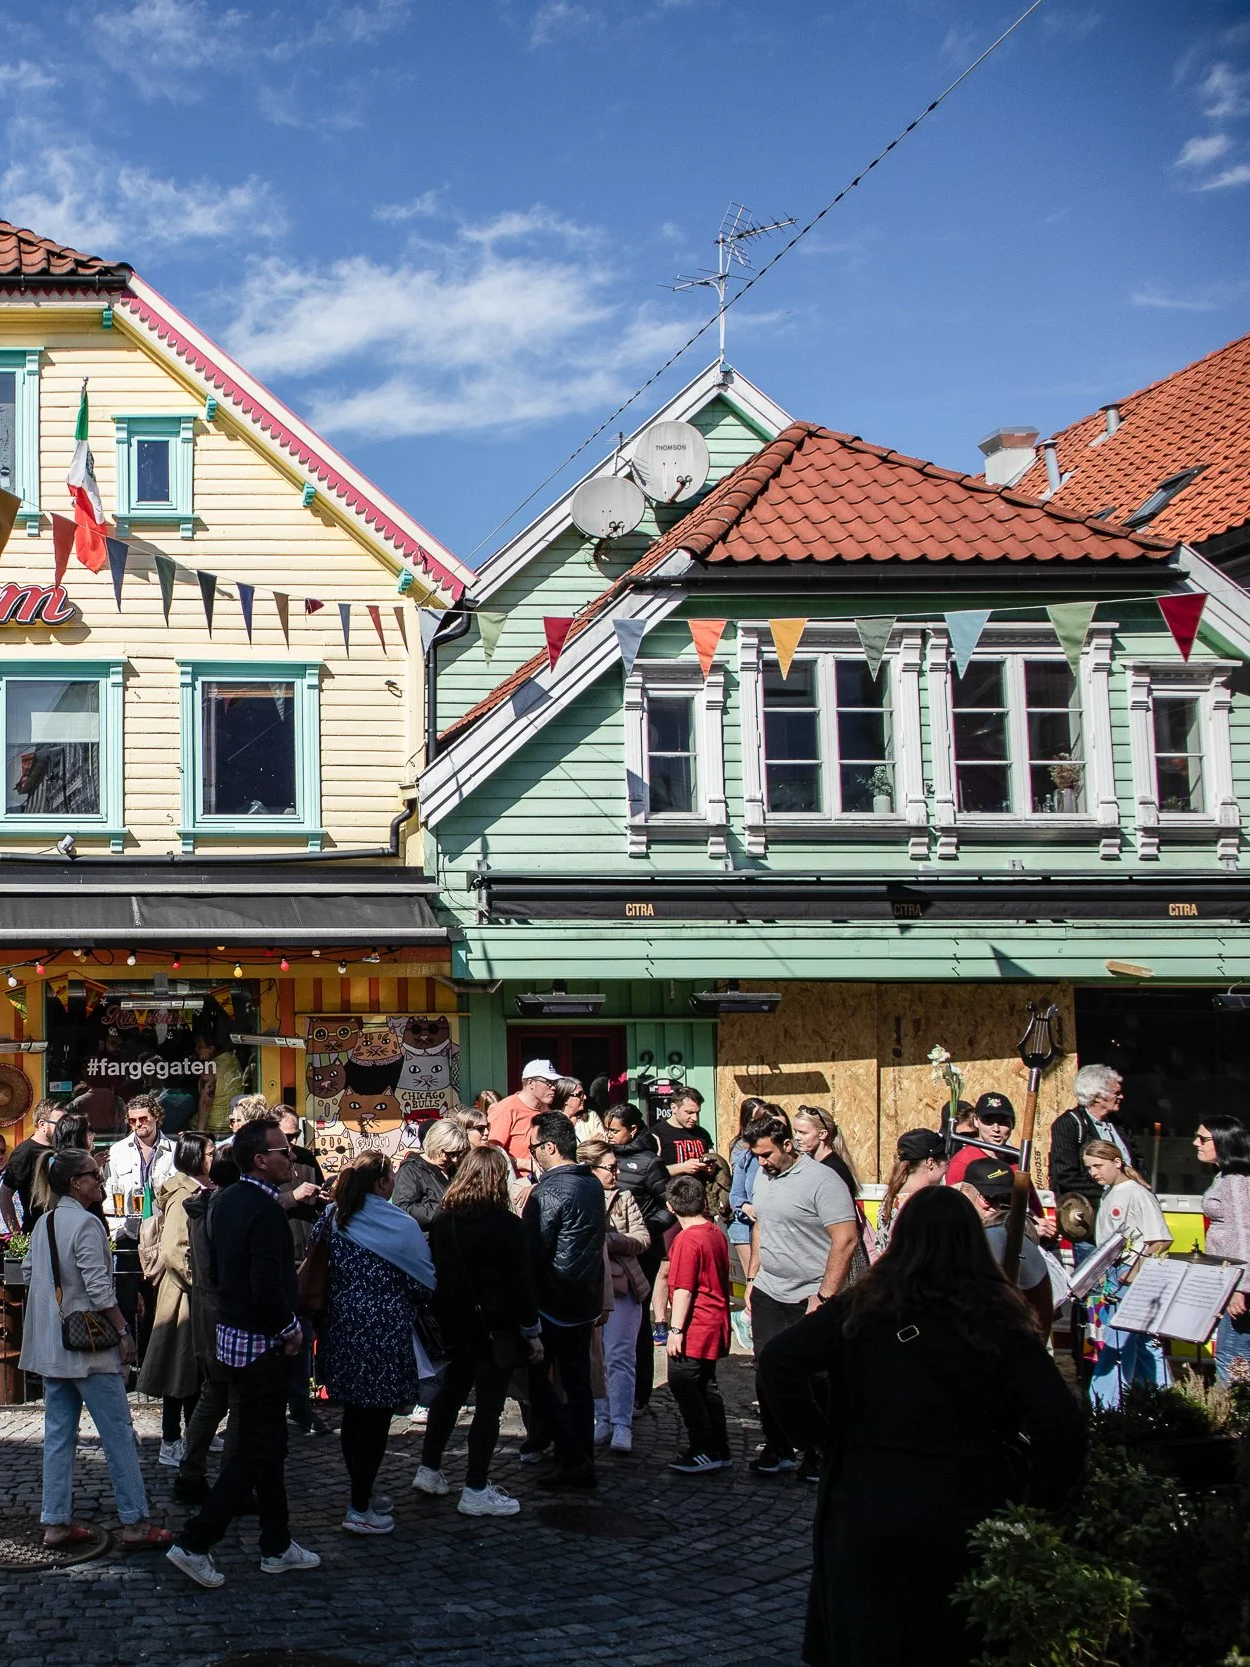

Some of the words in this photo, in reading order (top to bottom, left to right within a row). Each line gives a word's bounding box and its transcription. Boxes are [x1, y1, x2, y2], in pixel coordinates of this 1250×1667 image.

[87, 1058, 217, 1080] #fargegaten
[401, 1091, 445, 1101] CHICAGO
[412, 1100, 441, 1109] BULLS
[356, 1136, 390, 1150] GUCCI
